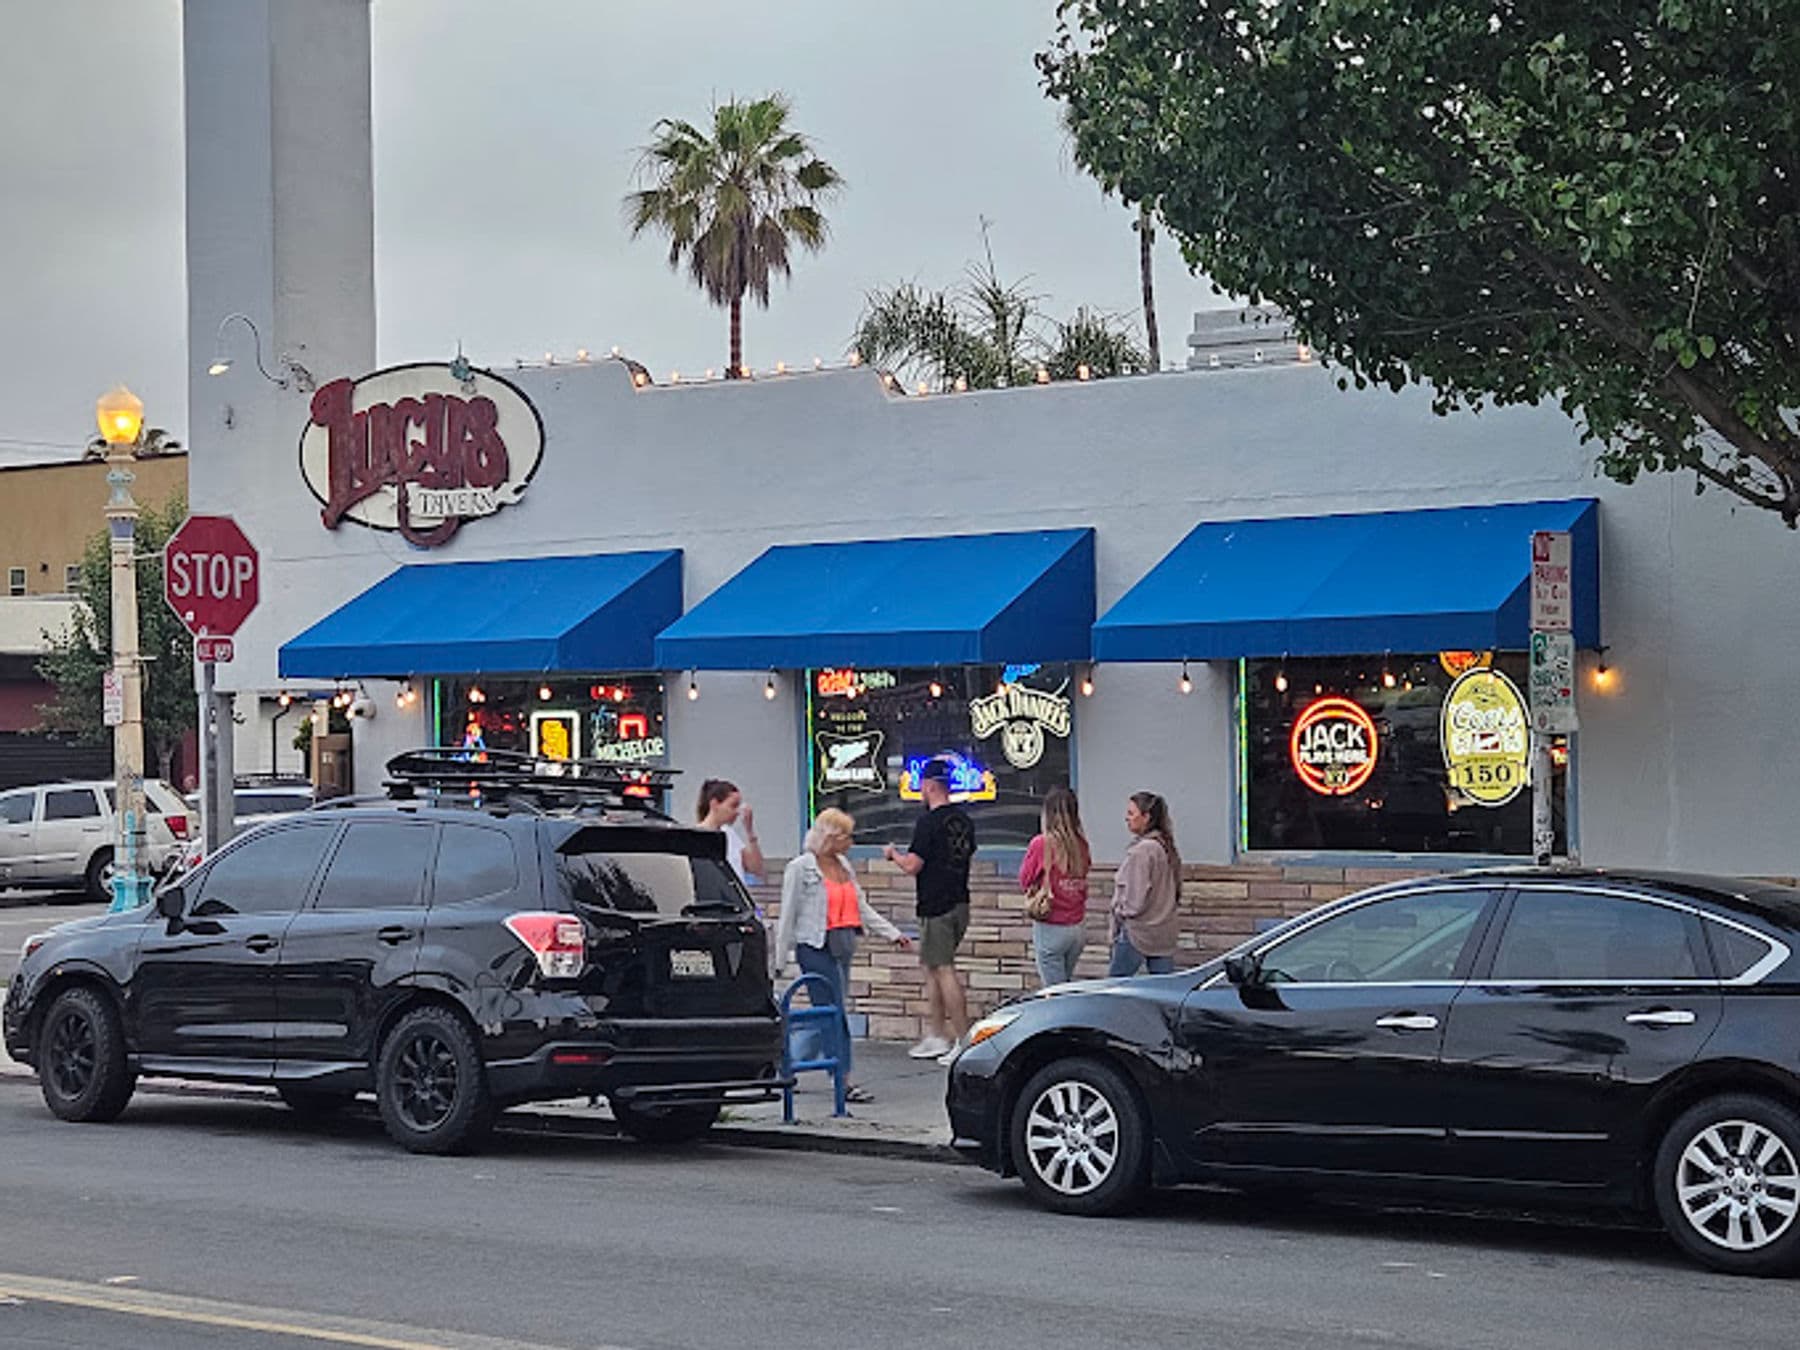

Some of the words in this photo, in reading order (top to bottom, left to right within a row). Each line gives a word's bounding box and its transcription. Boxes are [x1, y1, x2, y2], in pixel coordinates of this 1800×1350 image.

[419, 491, 496, 515] TAVERN
[171, 553, 253, 599] STOP
[972, 696, 1009, 731] JACK
[1009, 688, 1070, 734] DANIEL'S
[1451, 702, 1520, 731] Coors
[1300, 722, 1367, 750] JACK
[1463, 764, 1511, 785] 150
